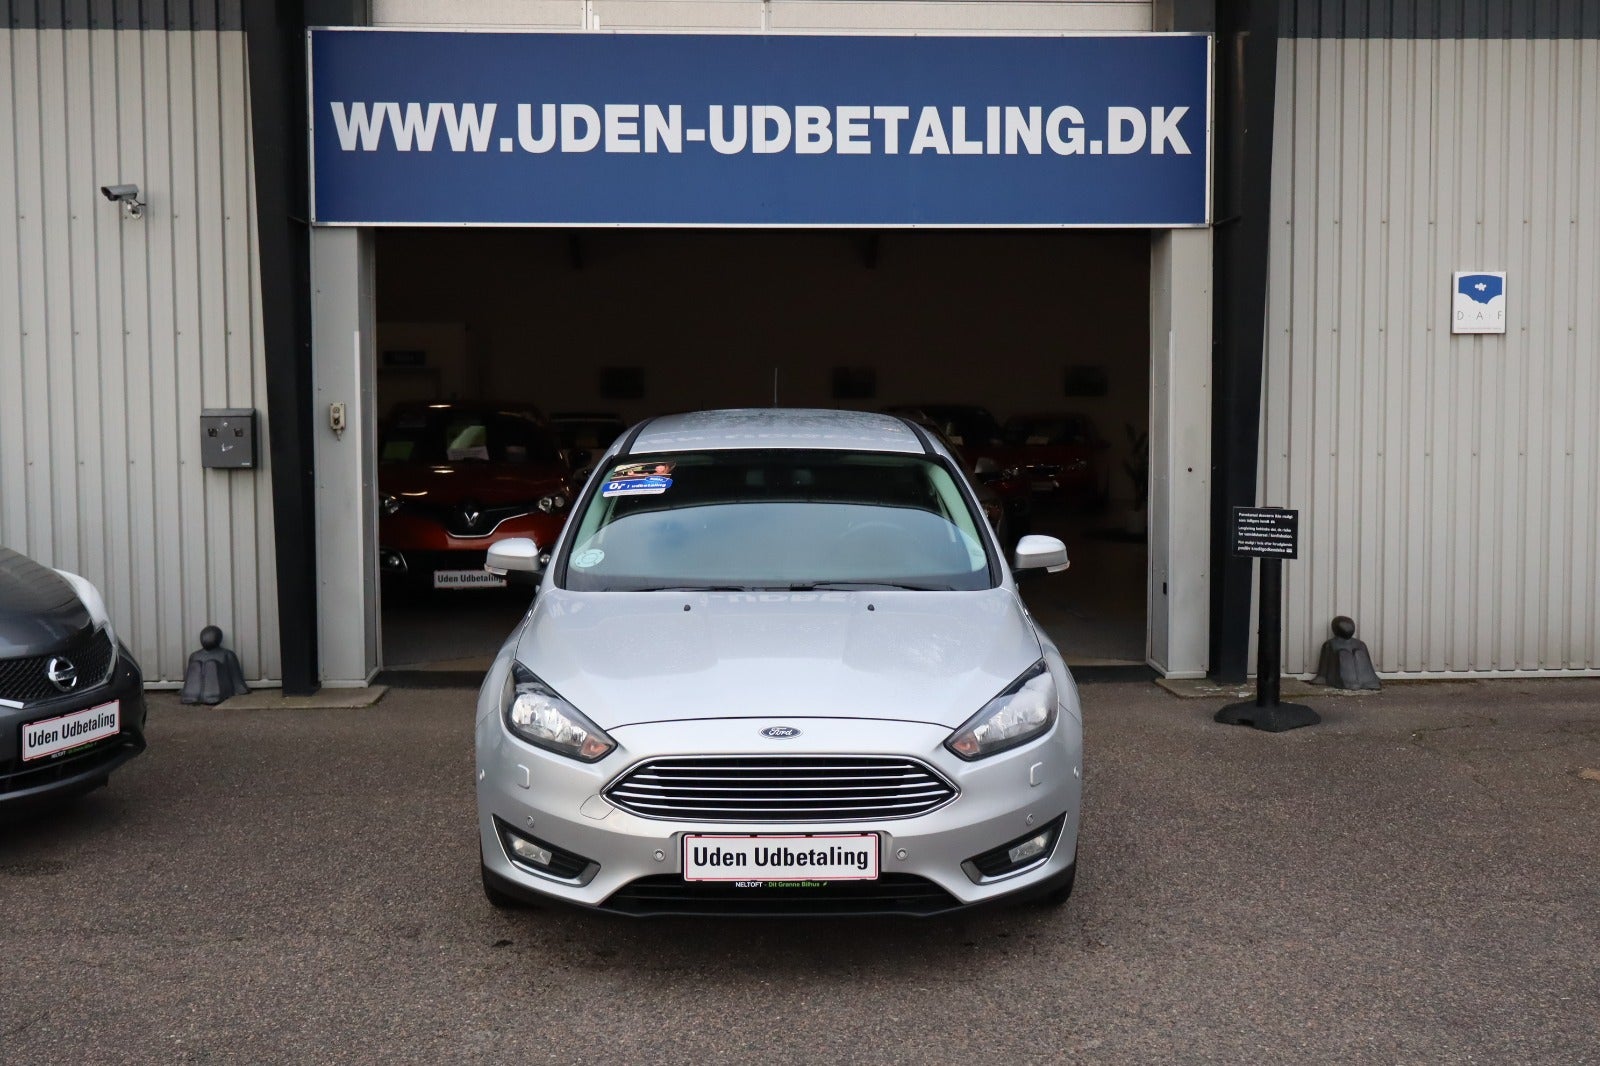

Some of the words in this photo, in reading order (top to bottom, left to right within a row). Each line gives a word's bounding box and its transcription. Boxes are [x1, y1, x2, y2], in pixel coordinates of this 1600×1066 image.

[329, 101, 1193, 157] WWW.UDEN-UDBETALING.DK
[437, 574, 459, 584] Uden
[28, 731, 58, 748] Uden
[61, 713, 115, 739] Udbetaling
[694, 846, 747, 867] Uden
[754, 846, 869, 870] Udbetaling
